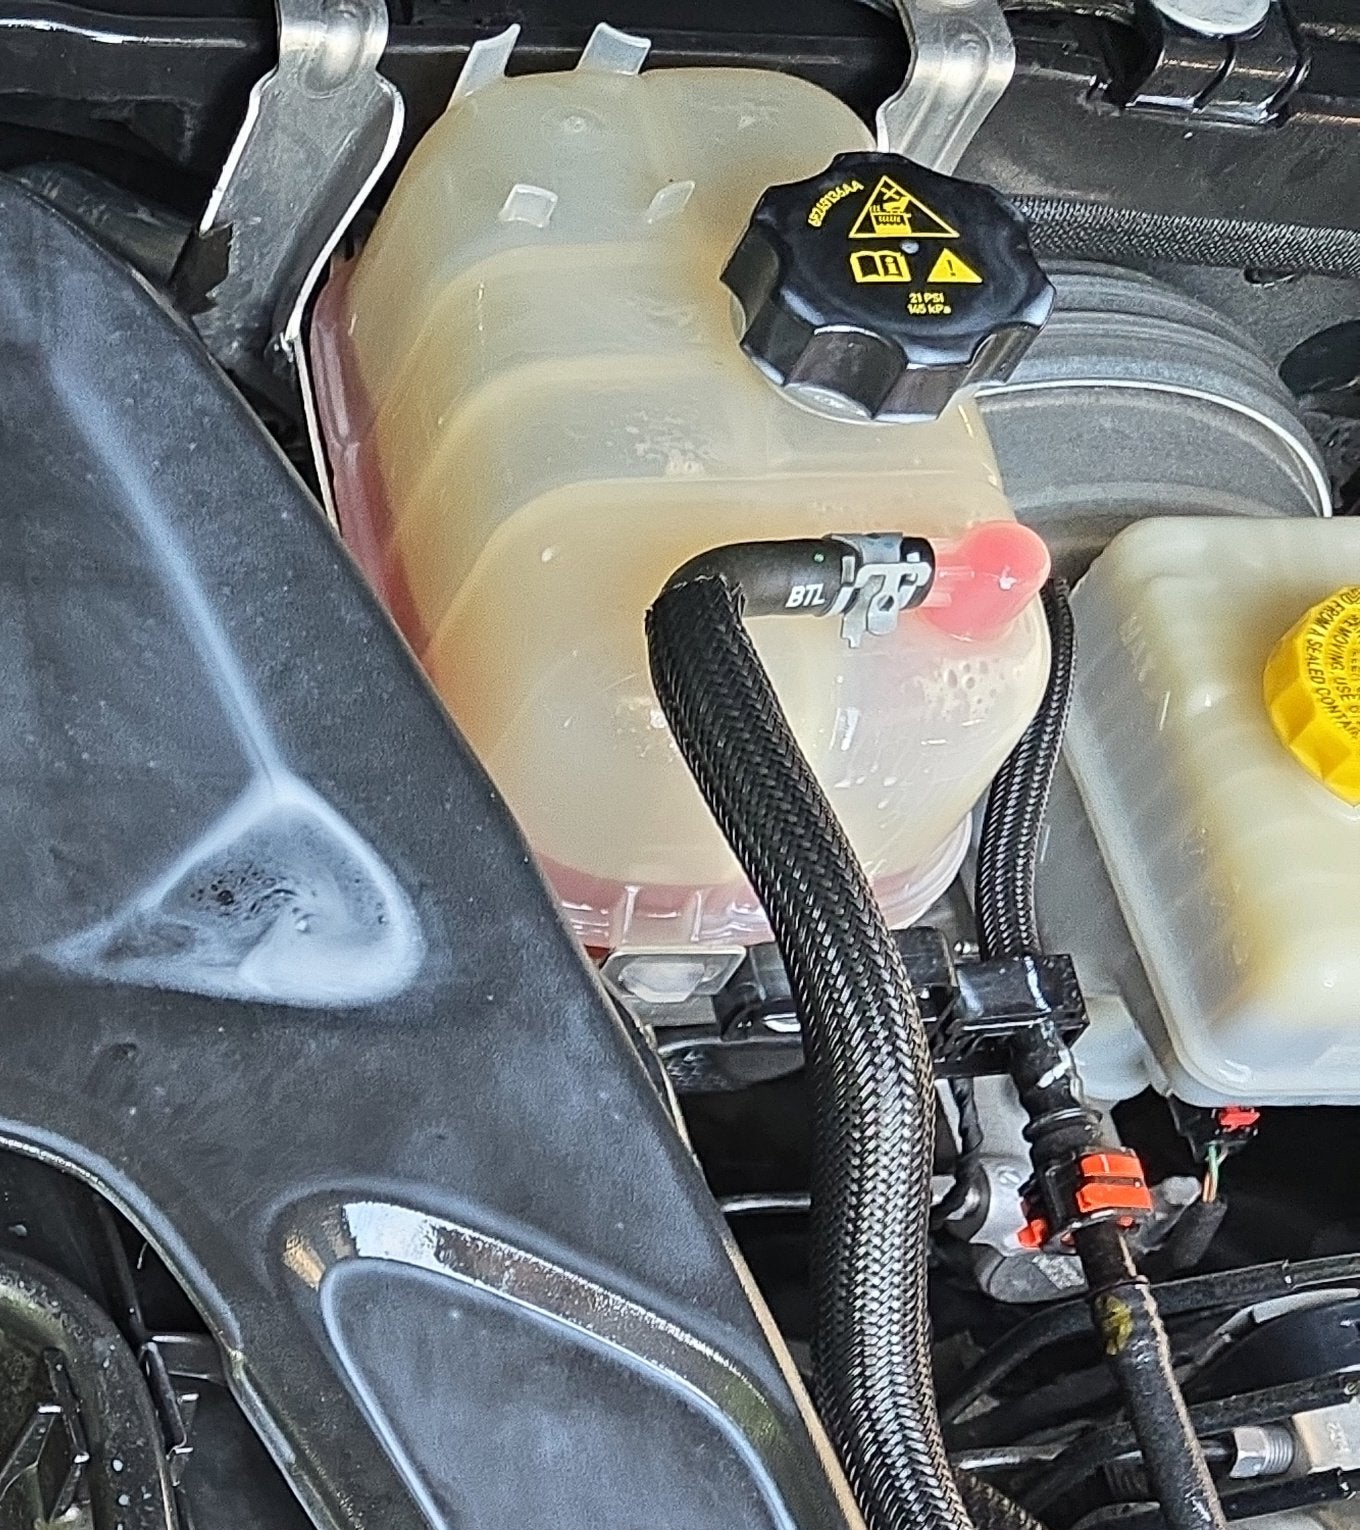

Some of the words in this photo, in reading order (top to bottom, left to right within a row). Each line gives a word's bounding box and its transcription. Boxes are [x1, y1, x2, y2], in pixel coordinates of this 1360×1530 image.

[909, 292, 922, 303] 21
[923, 292, 945, 303] PSI
[927, 303, 952, 315] kPa
[785, 583, 826, 608] BTL
[1314, 600, 1345, 631] FROM
[1308, 627, 1326, 638] A
[1306, 638, 1326, 685] SEALED
[1333, 677, 1356, 702] USE
